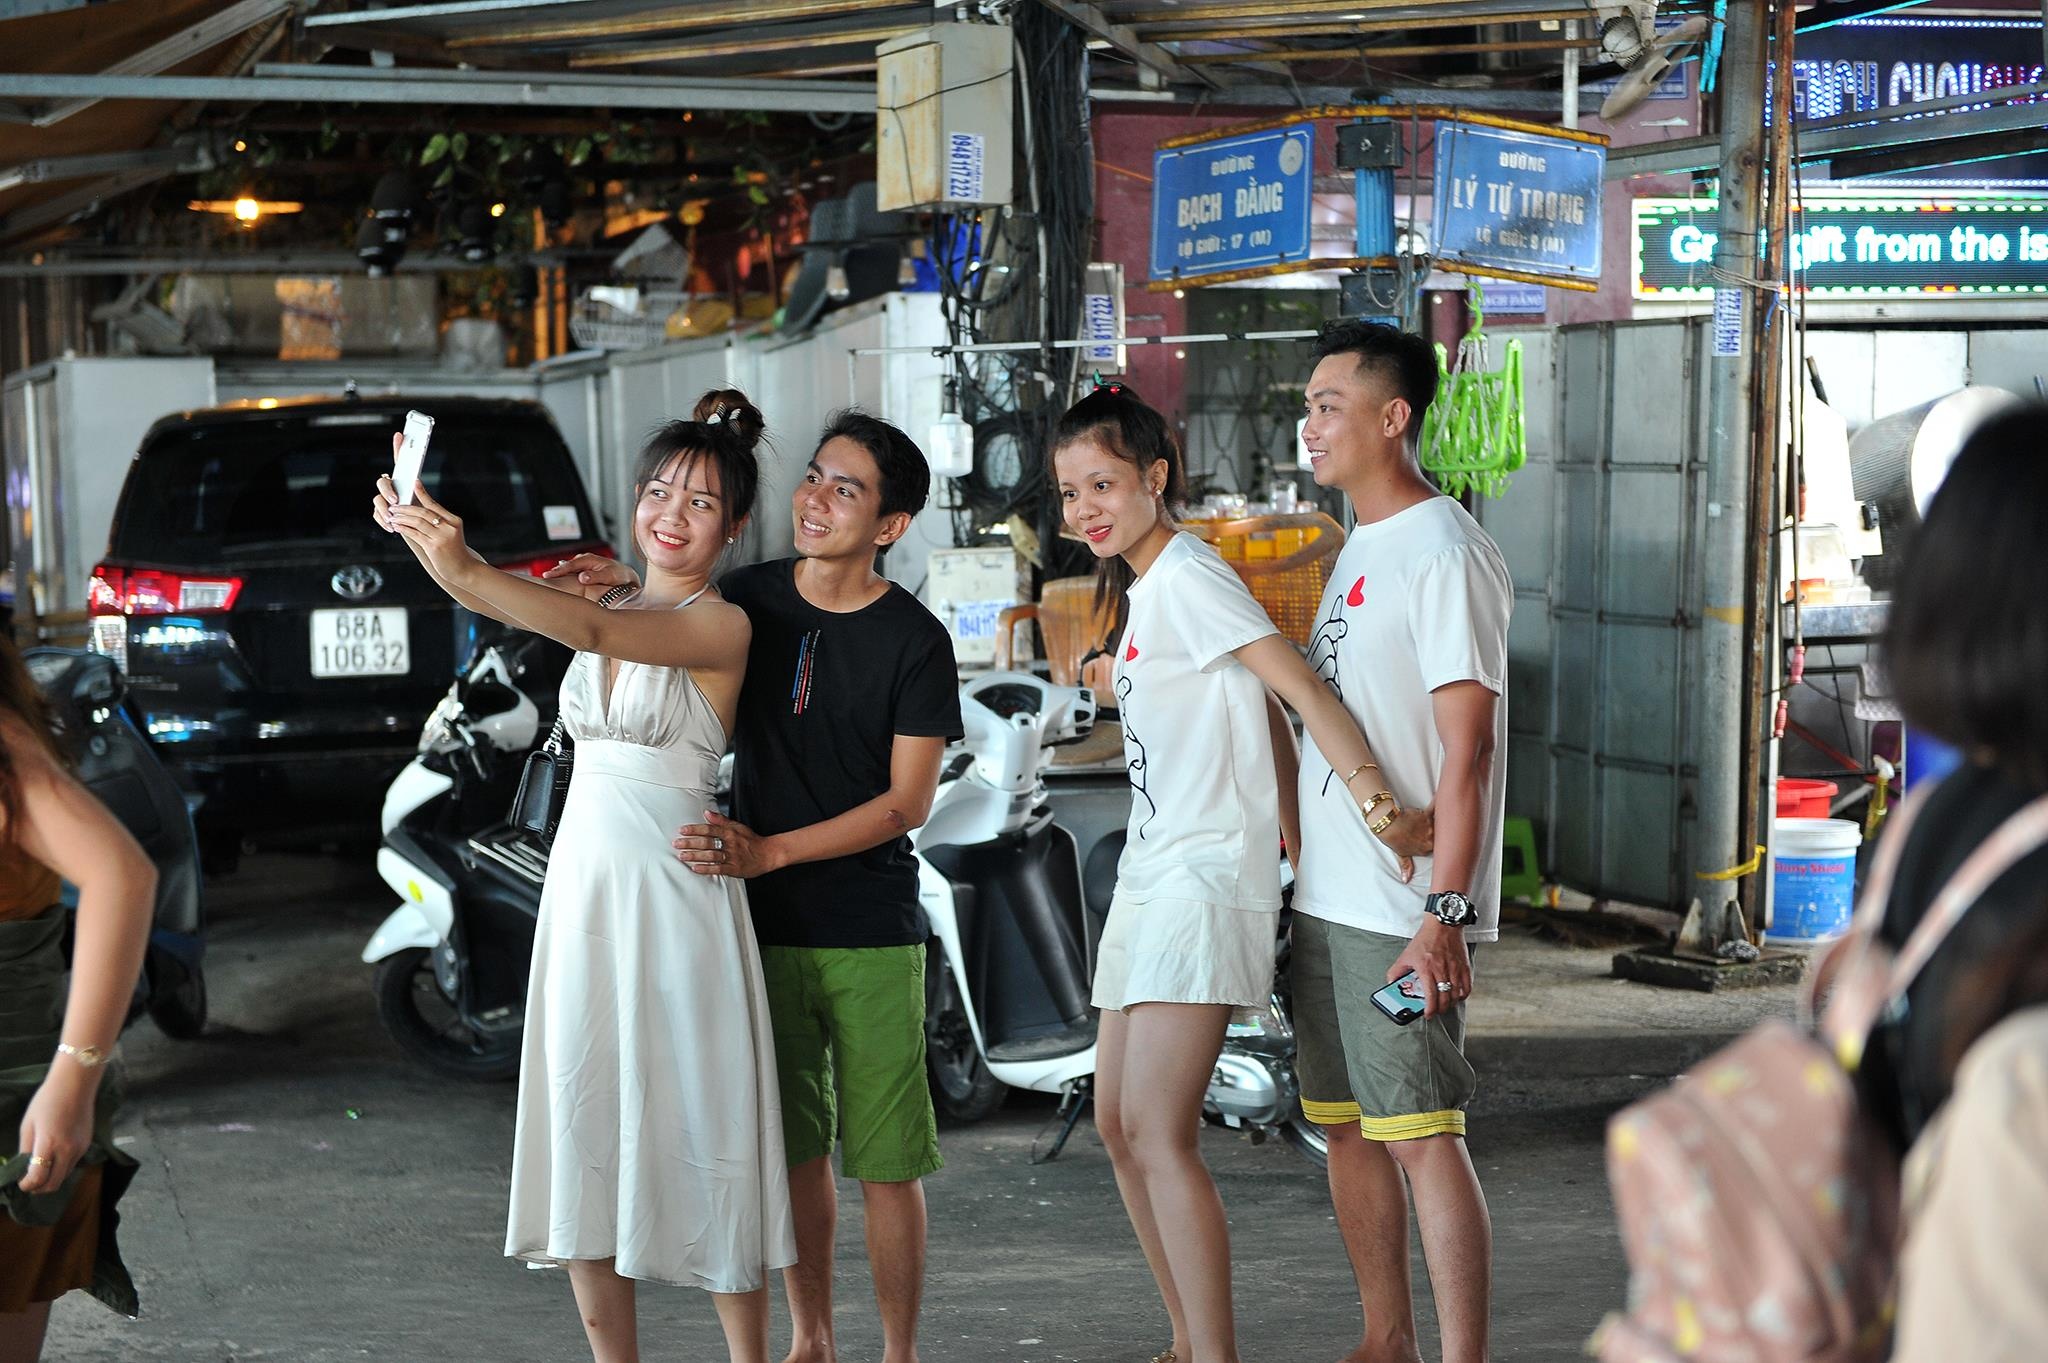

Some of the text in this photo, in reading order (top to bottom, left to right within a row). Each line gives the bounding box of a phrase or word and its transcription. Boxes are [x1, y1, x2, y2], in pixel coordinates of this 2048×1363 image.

[951, 134, 972, 199] 0948117222
[1211, 154, 1255, 176] ĐƯỜNG
[1499, 151, 1546, 173] ĐƯỜNG
[1178, 176, 1283, 231] BẠCH ĐẰNG
[1453, 174, 1584, 228] LÝ TỰ TRỌNG
[1789, 225, 1847, 271] gift
[1854, 225, 1942, 263] from
[1949, 225, 2010, 262] the
[336, 614, 384, 640] 68A
